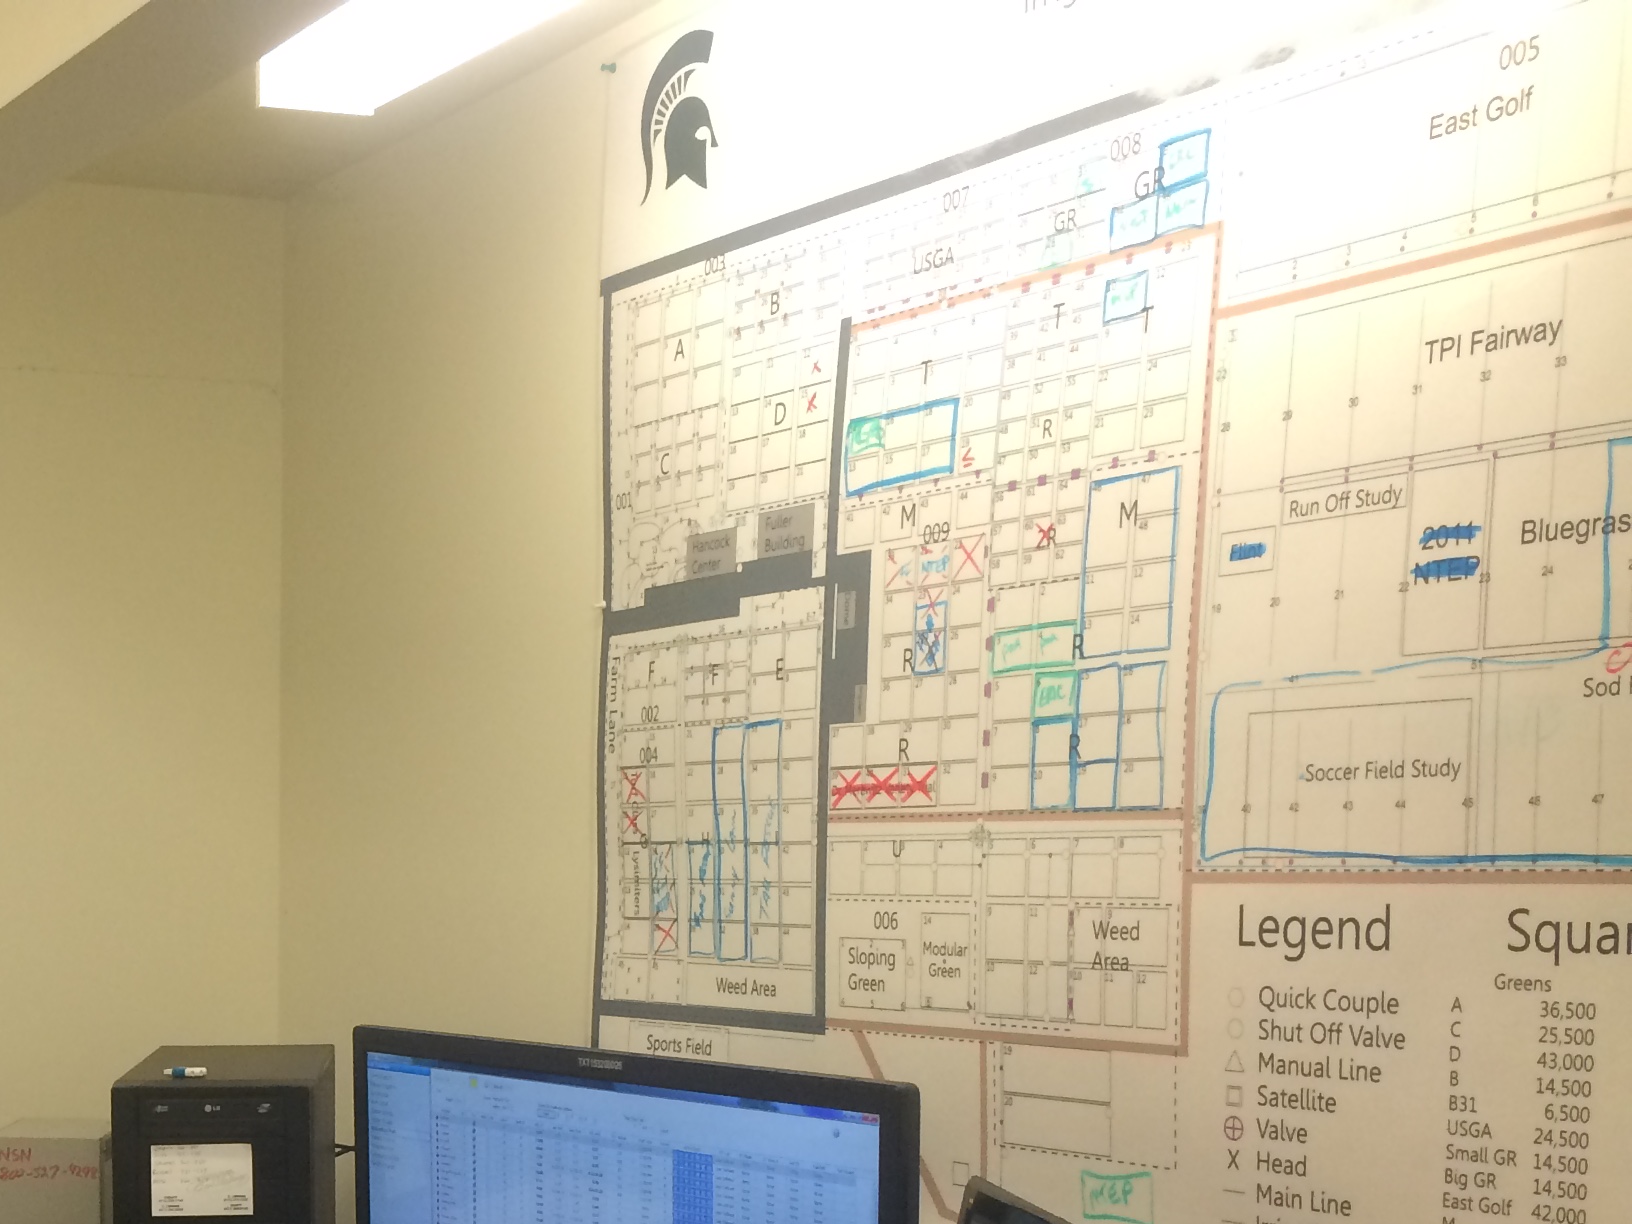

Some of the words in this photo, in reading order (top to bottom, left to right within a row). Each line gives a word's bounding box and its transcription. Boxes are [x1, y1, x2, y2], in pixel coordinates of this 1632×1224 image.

[1499, 35, 1541, 72] 005
[1428, 105, 1479, 141] East
[1486, 86, 1535, 124] Golf
[1110, 133, 1142, 161] 008
[1134, 165, 1167, 199] GR
[943, 186, 970, 214] 007
[704, 256, 726, 275] 003
[912, 246, 955, 275] USGA
[770, 291, 780, 315] B
[674, 338, 685, 362] A
[1425, 337, 1461, 366] TPI
[1469, 317, 1563, 358] Fairway
[920, 360, 933, 384] T
[774, 402, 787, 426] D
[1042, 418, 1052, 439] R
[660, 453, 670, 475] C
[1119, 499, 1138, 528] M
[1289, 499, 1320, 519] Run
[1324, 490, 1351, 514] Off
[1354, 484, 1403, 509] Study
[900, 503, 916, 529] M
[923, 522, 950, 544] 009
[1521, 513, 1632, 545] Bluegras
[764, 533, 806, 552] Building
[648, 661, 656, 682] F
[776, 658, 784, 681] E
[903, 648, 916, 672] R
[1583, 675, 1621, 698] Sod
[641, 705, 660, 722] 002
[639, 747, 658, 764] 004
[898, 738, 909, 762] R
[1305, 762, 1360, 782] Soccer
[1365, 759, 1405, 780] Field
[1410, 758, 1462, 782] Study
[892, 840, 902, 858] U
[873, 910, 899, 931] 006
[1092, 920, 1140, 941] Weed
[1238, 903, 1392, 962] Legend
[848, 947, 896, 971] Sloping
[922, 941, 968, 958] Modular
[1091, 951, 1130, 971] Area
[928, 962, 961, 979] Green
[716, 976, 747, 996] Weed
[751, 979, 777, 997] Area
[848, 974, 885, 993] Green
[1494, 973, 1552, 993] Greens
[1258, 986, 1316, 1012] Quick
[1322, 989, 1400, 1019] Couple
[1451, 997, 1463, 1014] A
[1539, 1000, 1597, 1021] 36,500
[646, 1034, 682, 1054] Sports
[686, 1038, 712, 1056] Field
[1258, 1019, 1304, 1044] Shut
[1310, 1022, 1343, 1046] Off
[1348, 1024, 1406, 1051] Valve
[1450, 1022, 1462, 1039] C
[1538, 1026, 1595, 1048] 25,500
[1258, 1052, 1331, 1080] Manual
[1338, 1058, 1382, 1084] Line
[1449, 1046, 1461, 1063] D
[1536, 1052, 1595, 1073] 43,000
[1450, 1071, 1459, 1088] B
[1536, 1077, 1592, 1099] 14,500
[1257, 1085, 1337, 1114] Satellite
[1448, 1095, 1478, 1114] B31
[1544, 1103, 1591, 1125] 6,500
[1256, 1118, 1308, 1144] Valve
[1447, 1119, 1493, 1140] USGA
[1533, 1127, 1590, 1151] 24,500
[1256, 1151, 1308, 1178] Head
[1446, 1144, 1489, 1164] Small
[1493, 1149, 1517, 1168] GR
[1533, 1153, 1589, 1176] 14,500
[1444, 1169, 1468, 1190] Big
[1473, 1172, 1497, 1190] GR
[1532, 1179, 1588, 1202] 14,500
[1256, 1184, 1302, 1210] Main
[1310, 1191, 1352, 1217] Line
[1442, 1192, 1474, 1213] East
[1478, 1197, 1513, 1217] Golf
